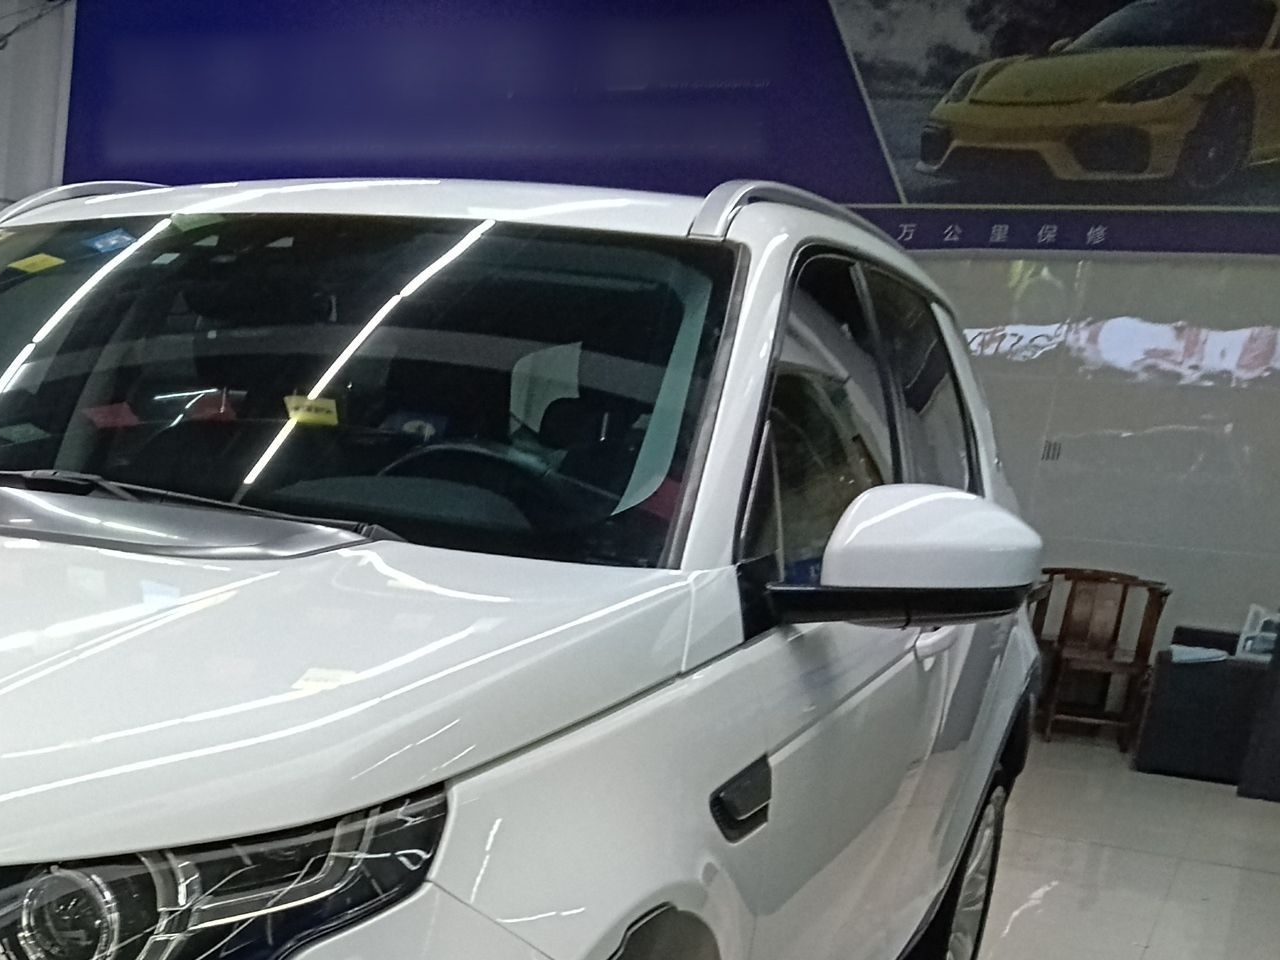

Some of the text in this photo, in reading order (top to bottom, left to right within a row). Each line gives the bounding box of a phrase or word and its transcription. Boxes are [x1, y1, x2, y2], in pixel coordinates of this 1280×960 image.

[897, 223, 1108, 245] 万公里保修
